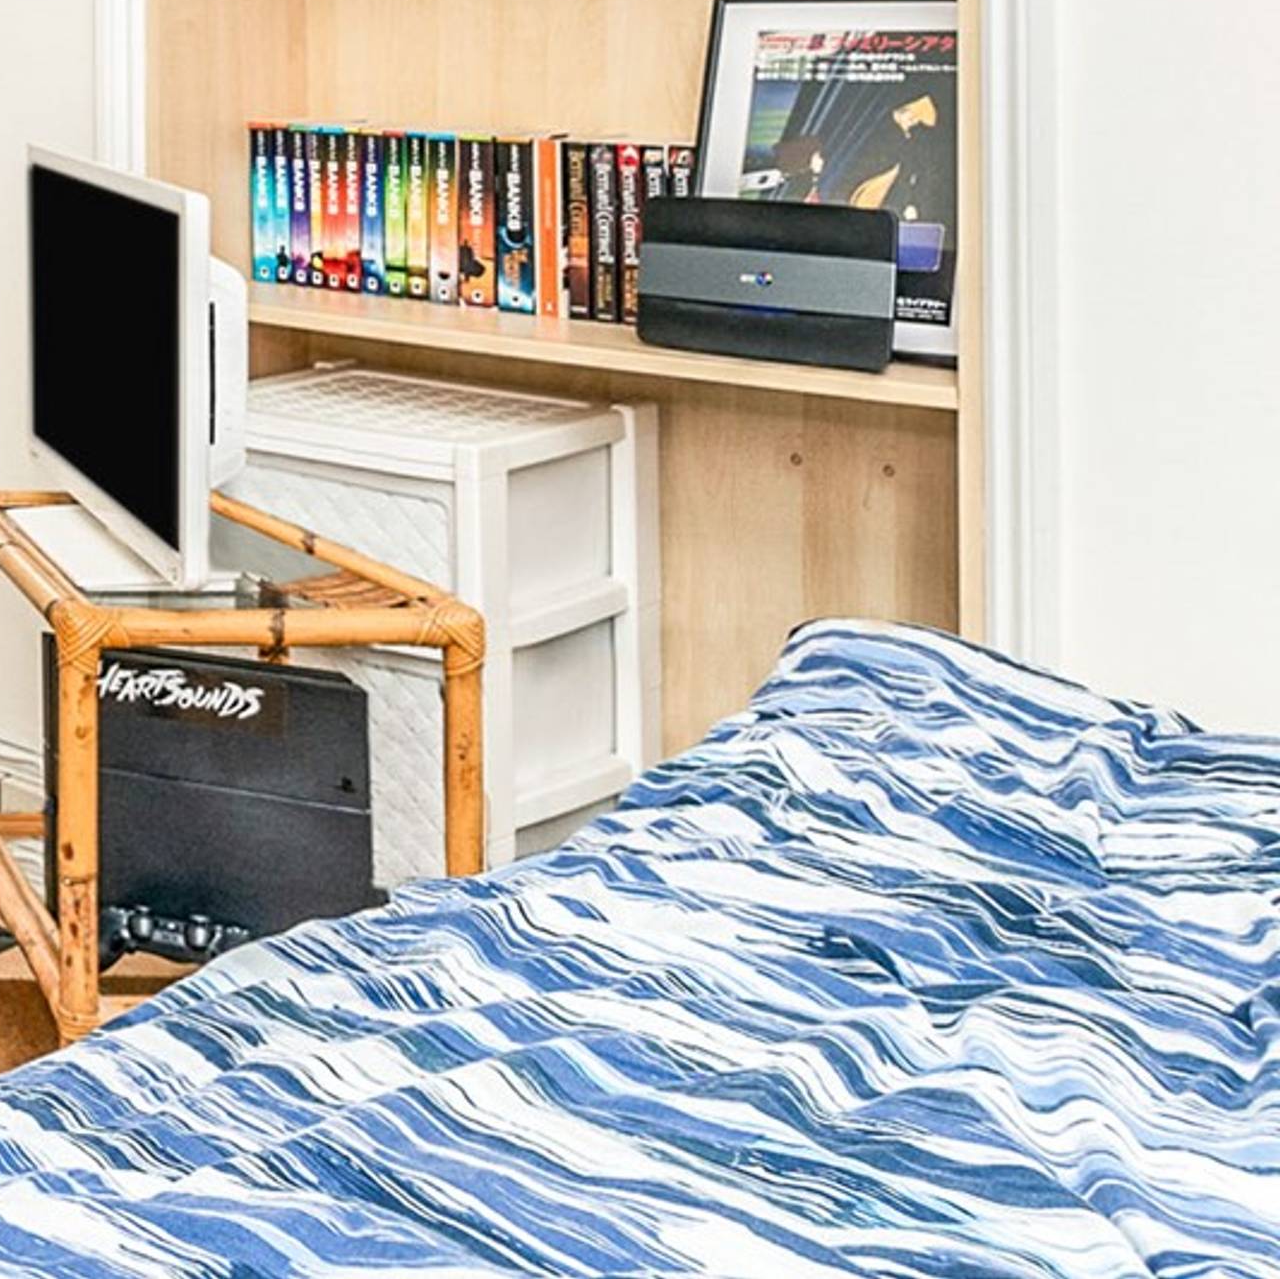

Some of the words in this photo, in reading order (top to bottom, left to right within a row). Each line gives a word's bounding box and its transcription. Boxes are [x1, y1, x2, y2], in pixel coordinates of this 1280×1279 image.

[294, 159, 305, 211] BANKS
[347, 161, 357, 215] BANKS
[366, 163, 376, 217] BANKS
[437, 168, 448, 224] BANKS
[470, 169, 483, 226] BANKS
[507, 172, 522, 231] BANKS
[647, 167, 662, 197] Bern
[673, 168, 690, 196] Bern
